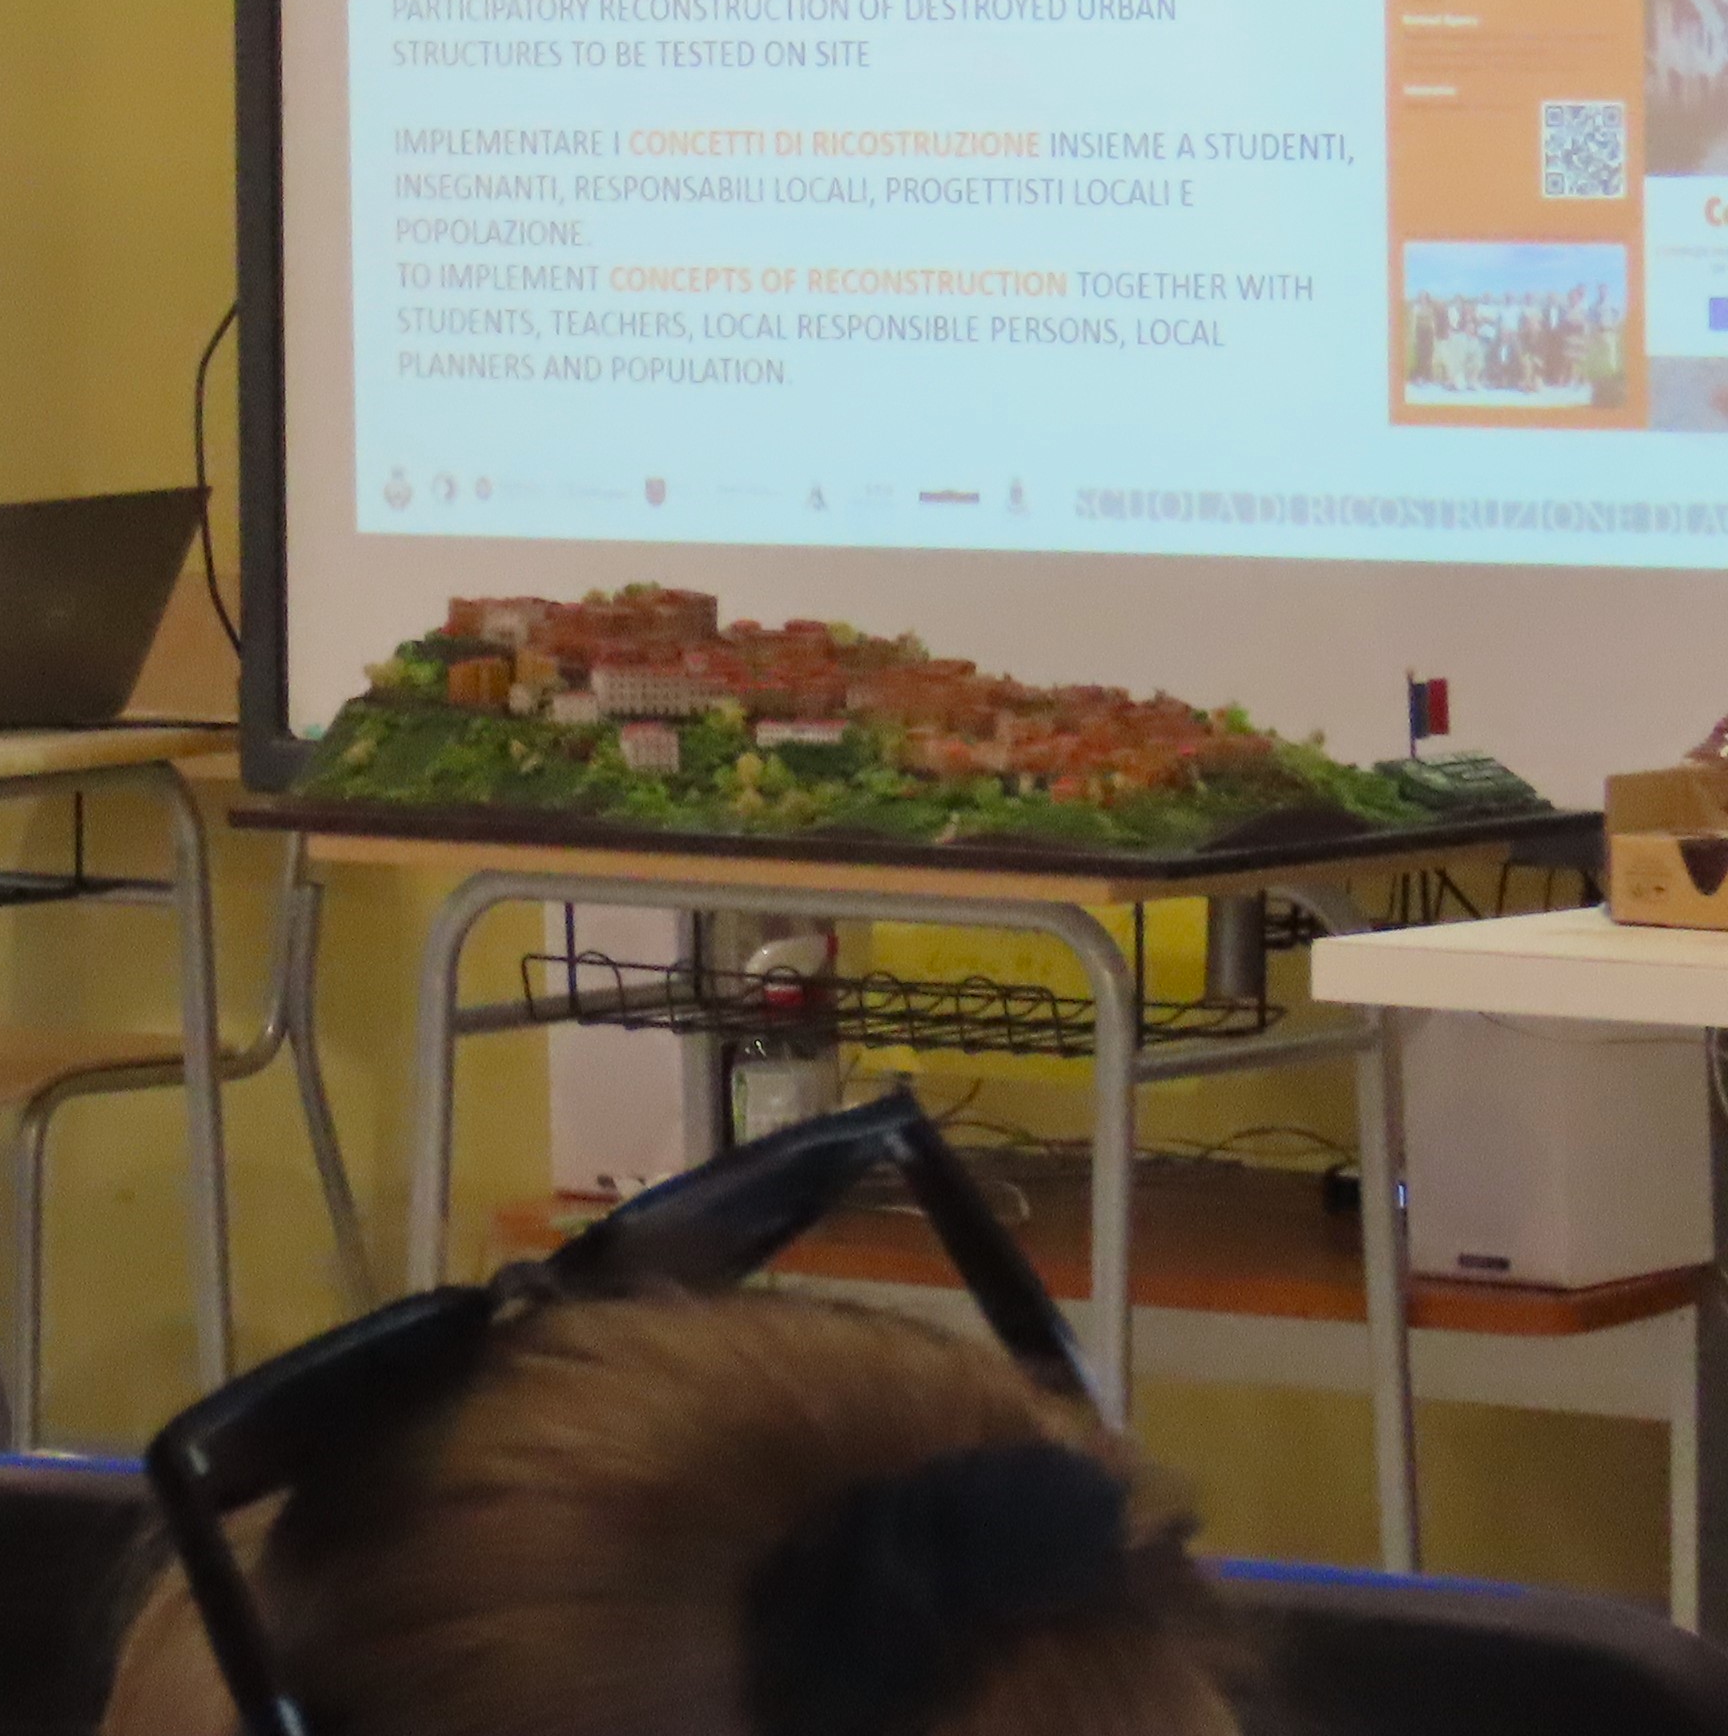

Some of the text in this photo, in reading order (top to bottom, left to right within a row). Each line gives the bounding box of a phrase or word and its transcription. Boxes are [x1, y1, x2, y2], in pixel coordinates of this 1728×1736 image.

[393, 40, 870, 67] STRUCTURES TO BE TESTED ON SITE
[395, 128, 1355, 165] IMPLEMENTARE I CONCETTI DI RICOSTRUZIONE INSIEME A STUDENTI,
[395, 174, 1195, 207] INSEGNANTI, RESPONSABILI LOCALI, PROGETTISTI LOCALI E
[398, 262, 1314, 301] TO IMPLEMENT CONCEPTS OF RECONSTRUCTION TOGETHER WITH
[397, 307, 1226, 349] STUDENTS, TEACHERS, LOCAL RESPONSIBLE PERSONS, LOCAL
[398, 351, 535, 381] PLANNERS
[543, 353, 602, 382] AND
